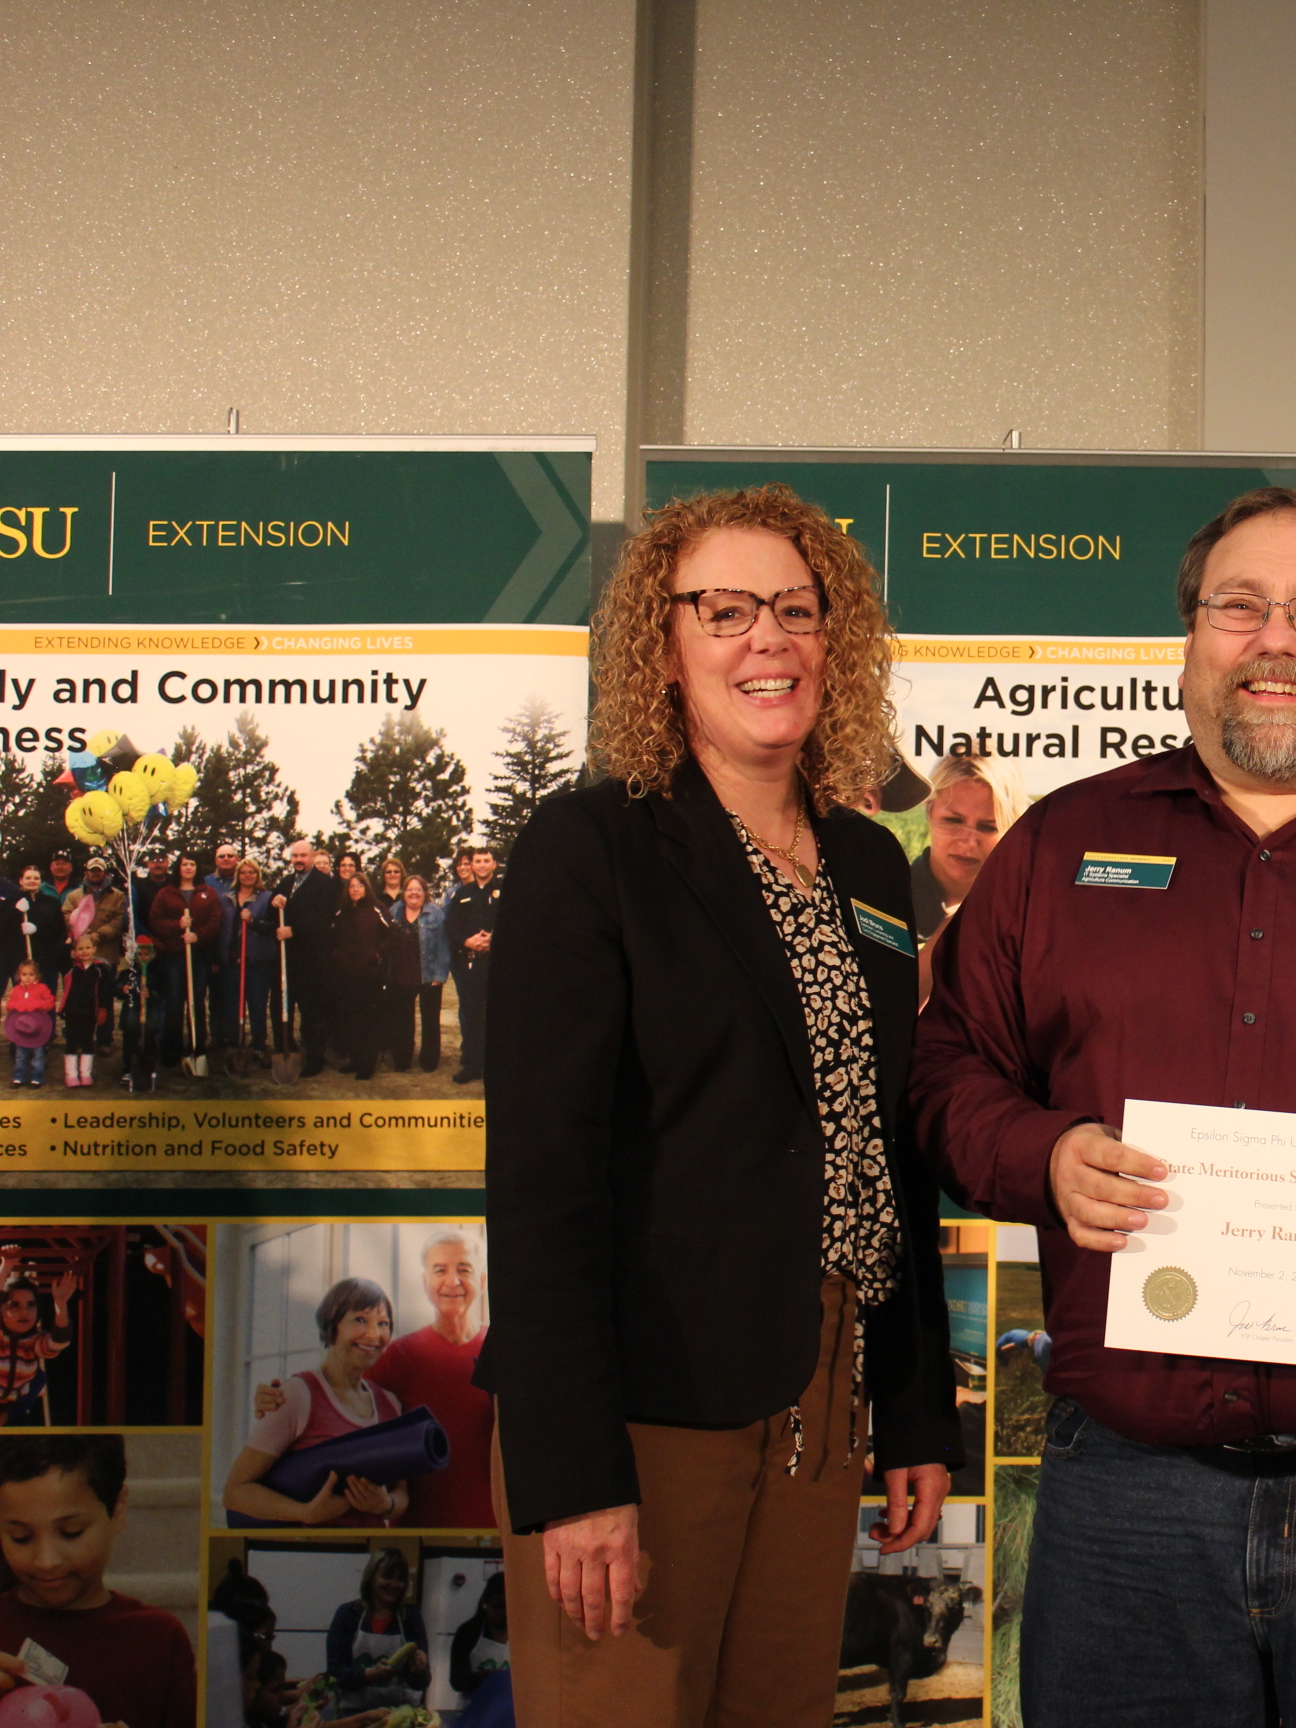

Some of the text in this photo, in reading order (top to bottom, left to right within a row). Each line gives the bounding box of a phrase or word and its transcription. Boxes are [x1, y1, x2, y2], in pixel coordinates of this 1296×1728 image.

[148, 520, 350, 547] EXTENSION
[921, 532, 1122, 560] EXTENSION
[34, 636, 413, 650] EXTENDING KNOWLEDGE CHANGING LIVES
[913, 645, 1021, 659] KNOWLEDGE
[1045, 646, 1136, 660] CHANGING
[1139, 647, 1185, 661] LIVES
[52, 669, 139, 704] and
[157, 669, 428, 711] Community
[914, 724, 1080, 758] Natural
[1085, 864, 1132, 874] Jerry Ranum
[63, 1112, 186, 1131] Leadership,
[193, 1112, 306, 1129] Volunteers
[313, 1112, 352, 1129] and
[1190, 1127, 1229, 1142] Epsilon
[1232, 1131, 1267, 1147] Sigma
[1270, 1134, 1287, 1147] Phi
[63, 1139, 339, 1159] Nutrition and Food Safety
[1159, 1158, 1195, 1175] tate
[1198, 1162, 1286, 1182] Meritorious
[1254, 1199, 1292, 1211] Presented
[1220, 1221, 1266, 1241] Jerry
[1228, 1266, 1275, 1279] November
[1278, 1270, 1287, 1282] 2,
